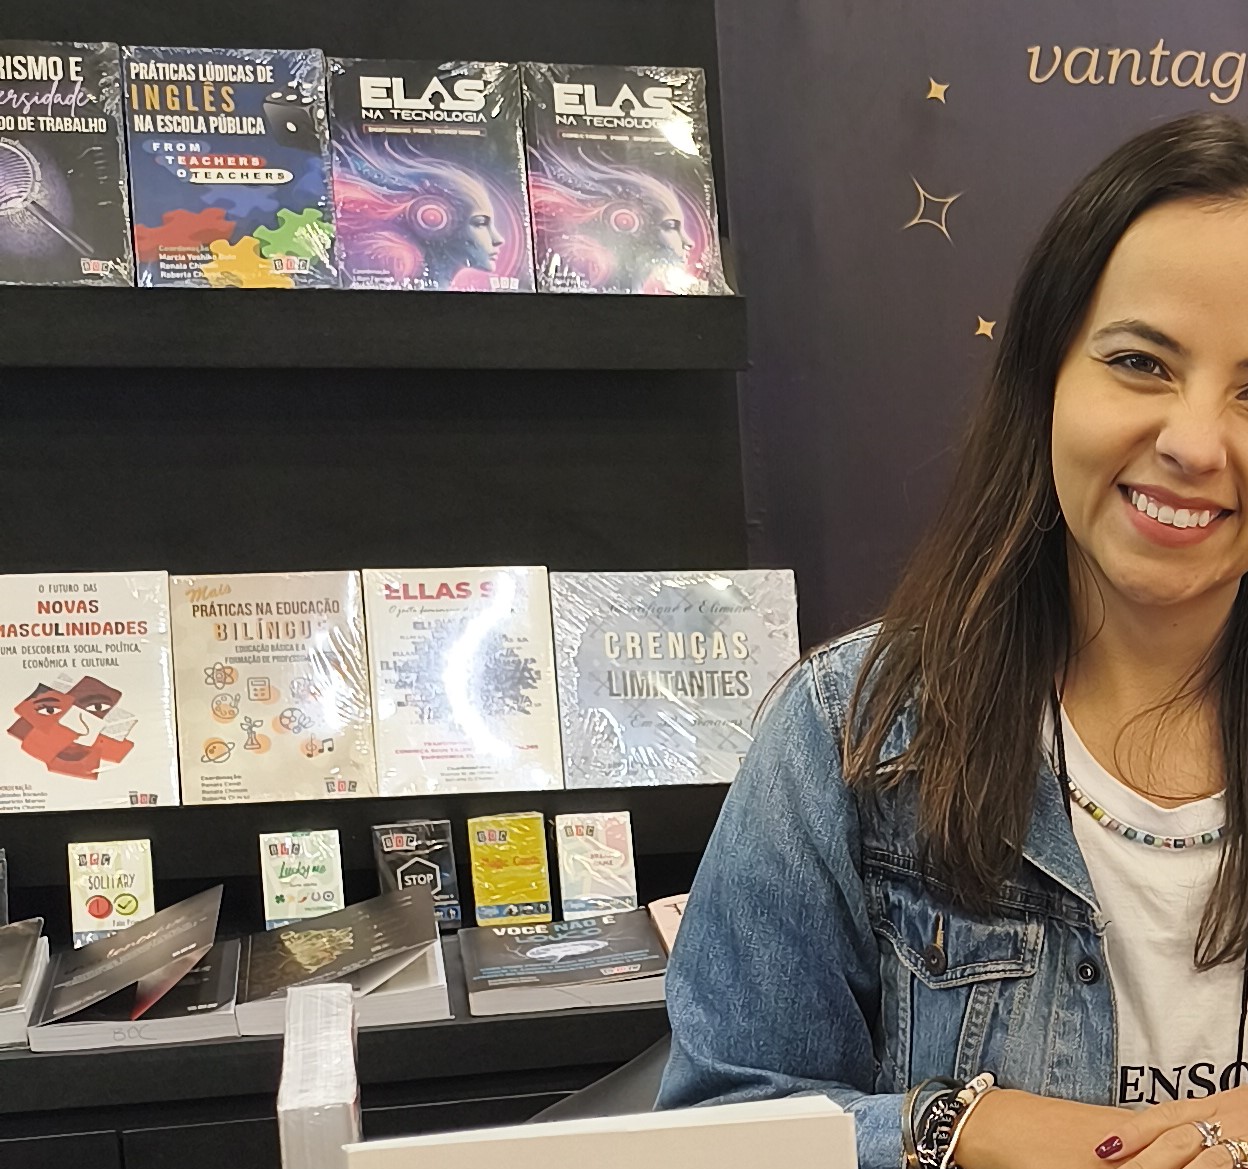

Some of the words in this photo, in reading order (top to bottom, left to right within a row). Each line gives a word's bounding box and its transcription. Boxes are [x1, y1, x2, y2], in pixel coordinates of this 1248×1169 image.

[69, 56, 84, 81] E
[129, 60, 196, 81] PRÁTICAS
[198, 61, 255, 83] LÚDICAS
[256, 65, 275, 83] DE
[131, 81, 236, 113] INGLÊS
[359, 75, 486, 112] ELAS
[553, 83, 674, 119] ELAS
[17, 116, 36, 131] DE
[37, 117, 107, 133] TRABALHO
[133, 114, 154, 132] NA
[156, 115, 207, 134] ESCOLA
[209, 114, 266, 135] PÚBLICA
[361, 109, 384, 121] NA
[393, 109, 488, 124] TECNOLOGIA
[555, 114, 578, 126] NA
[152, 142, 201, 153] FROM
[165, 156, 261, 167] TEACHERS
[193, 171, 286, 180] TEACHERS
[38, 584, 45, 593] O
[48, 583, 80, 593] FUTURO
[83, 583, 98, 592] DAS
[184, 583, 232, 603] Mais
[384, 581, 473, 601] ELLAS
[37, 599, 99, 614] NOVAS
[191, 601, 253, 618] PRÁTICAS
[255, 604, 273, 616] NA
[276, 598, 340, 615] EDUCAÇÃO
[0, 645, 17, 656] UMA
[21, 644, 70, 655] DESCOBERTA
[604, 631, 750, 664] CRENÇAS
[22, 656, 69, 669] ECONÔMICA
[72, 658, 77, 668] E
[81, 657, 120, 668] CULTURAL
[607, 669, 753, 700] LIMITANTES
[88, 873, 136, 891] SOLITARY
[404, 873, 434, 886] STOP
[514, 927, 602, 944] LOUCO
